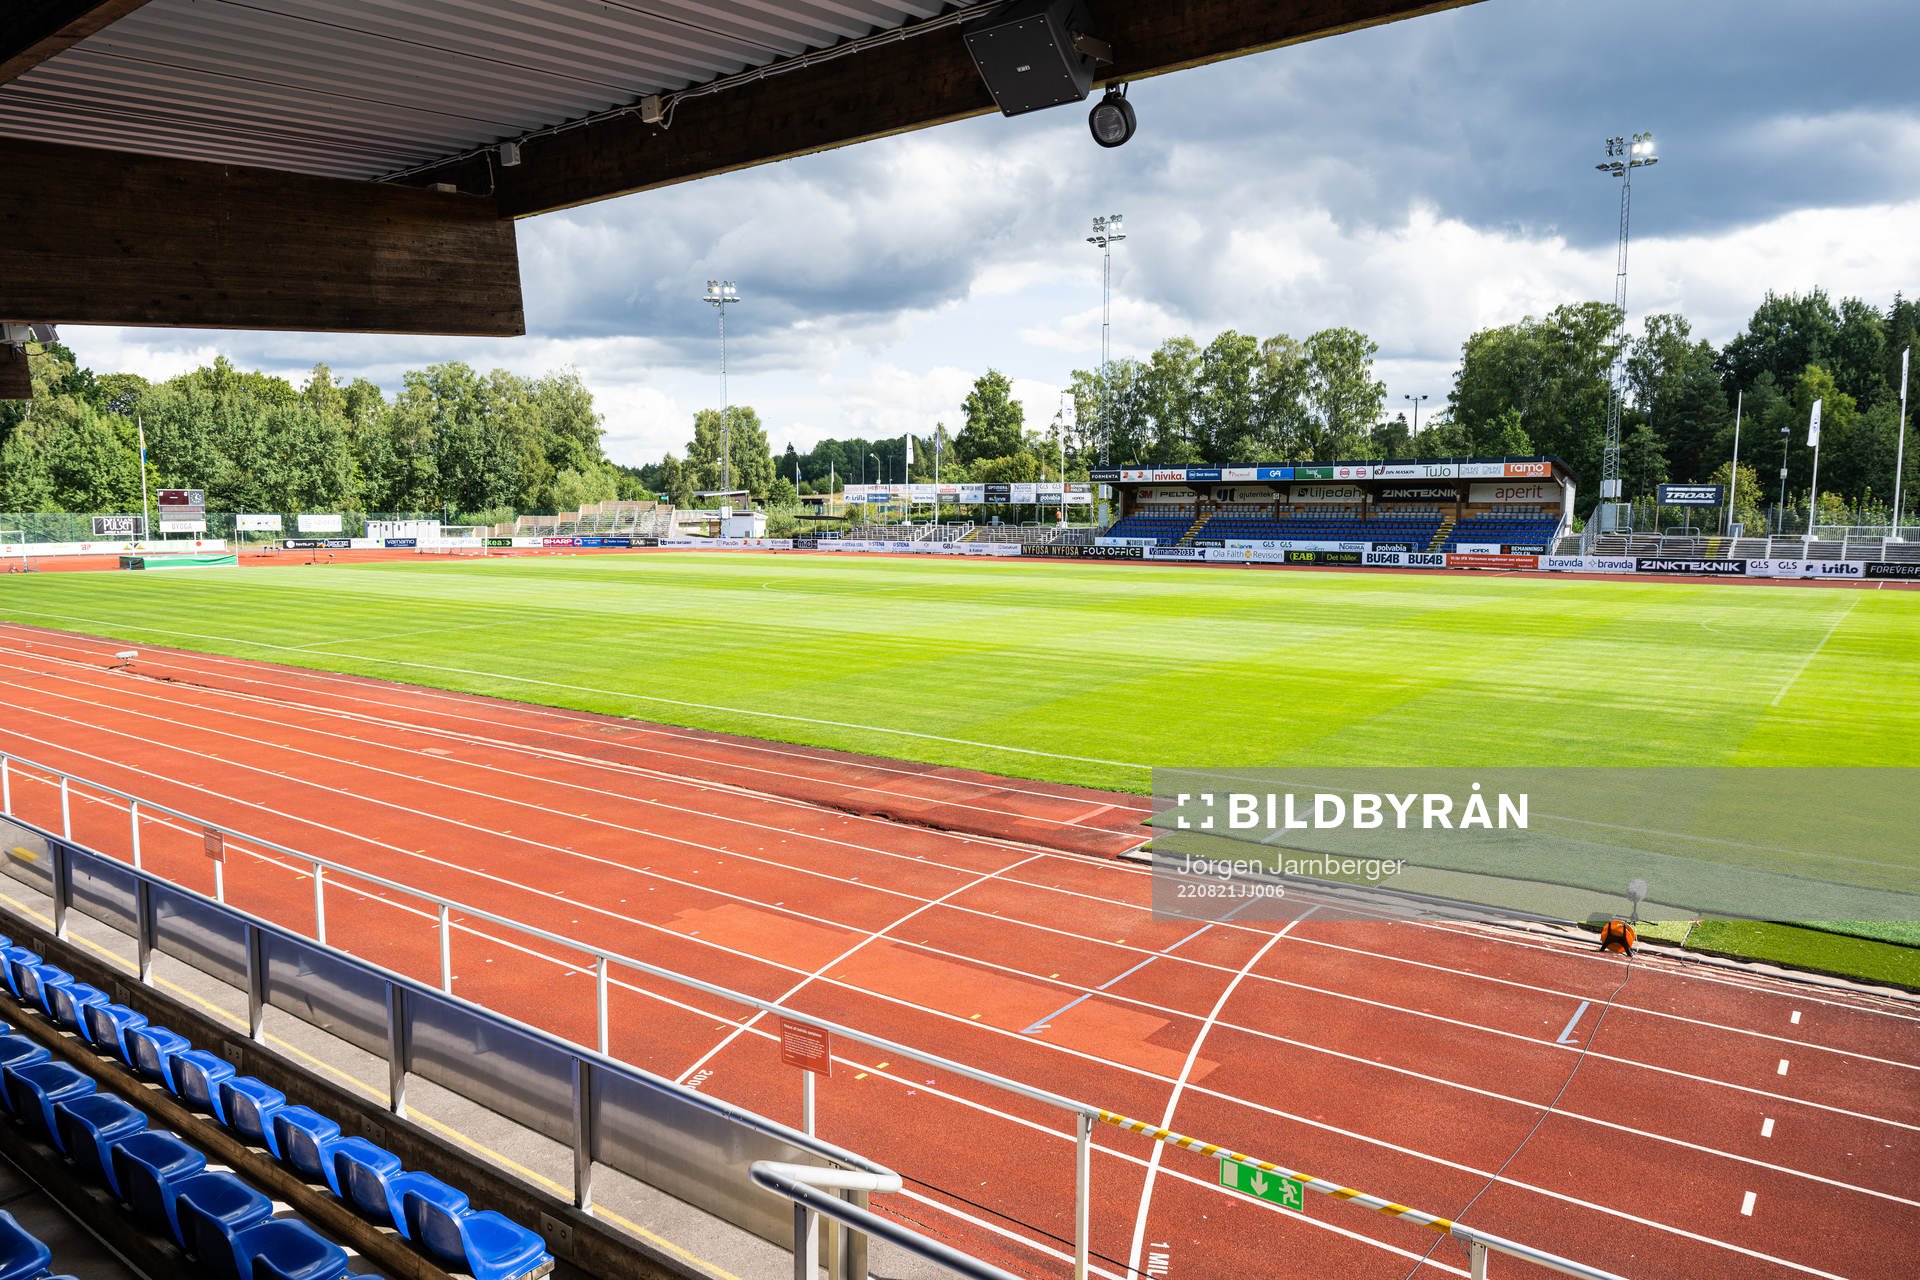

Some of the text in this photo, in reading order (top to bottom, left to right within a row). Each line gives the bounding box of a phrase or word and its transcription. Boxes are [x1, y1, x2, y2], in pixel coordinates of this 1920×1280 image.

[1510, 463, 1544, 473] ramo
[1139, 491, 1153, 499] 3M
[1310, 488, 1362, 500] Liljedah
[1382, 488, 1458, 498] ZINKTEKNIK
[1495, 485, 1543, 501] aperit
[1666, 491, 1716, 499] TROAX
[1022, 545, 1049, 555] NYFOSA
[1052, 546, 1079, 556] NYFOSA
[1083, 547, 1141, 557] FOUR OFFICE
[1213, 550, 1225, 558] Ola
[1253, 550, 1283, 559] Revision
[1366, 553, 1400, 564] BUFAB
[1408, 553, 1443, 565] BUFAB
[1548, 558, 1633, 569] bravida bravida
[1640, 560, 1741, 571] ZINKTEKNIK
[1750, 560, 1797, 570] GLS GLS
